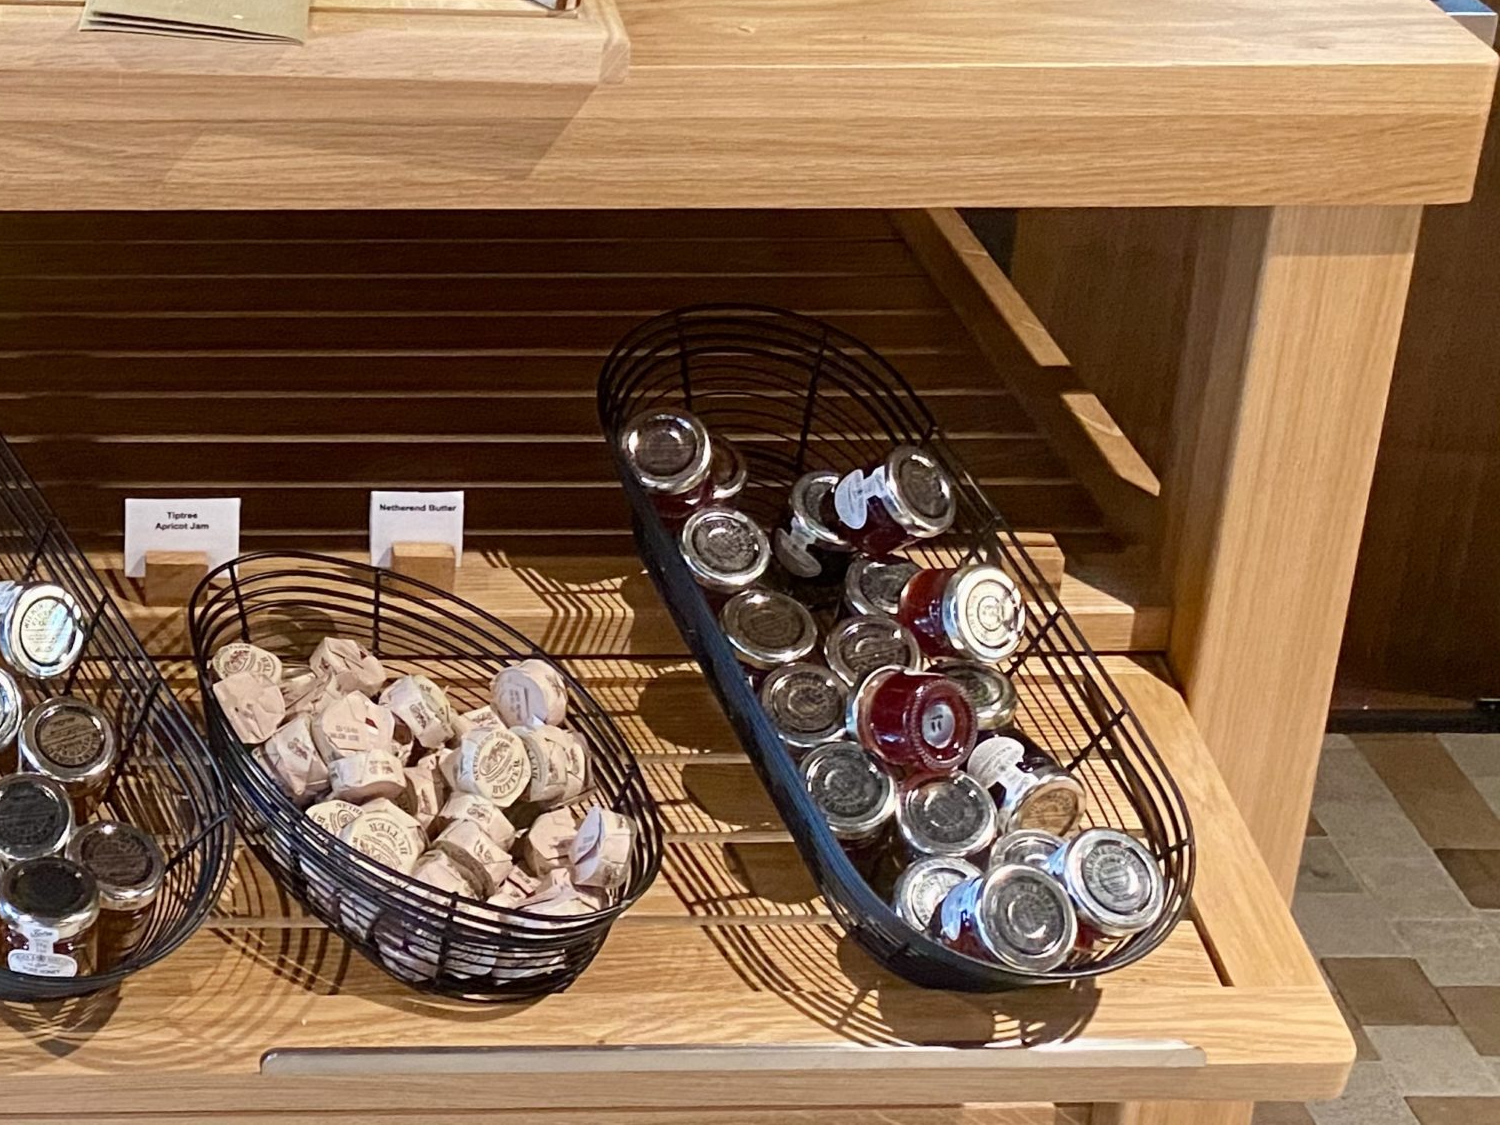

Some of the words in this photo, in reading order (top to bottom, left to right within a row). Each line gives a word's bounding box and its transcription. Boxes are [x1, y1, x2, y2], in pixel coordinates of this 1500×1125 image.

[379, 503, 427, 512] Netherend
[428, 504, 457, 512] Butter
[167, 511, 198, 520] Tiptree
[155, 522, 188, 530] Apricot
[190, 522, 209, 530] Jam
